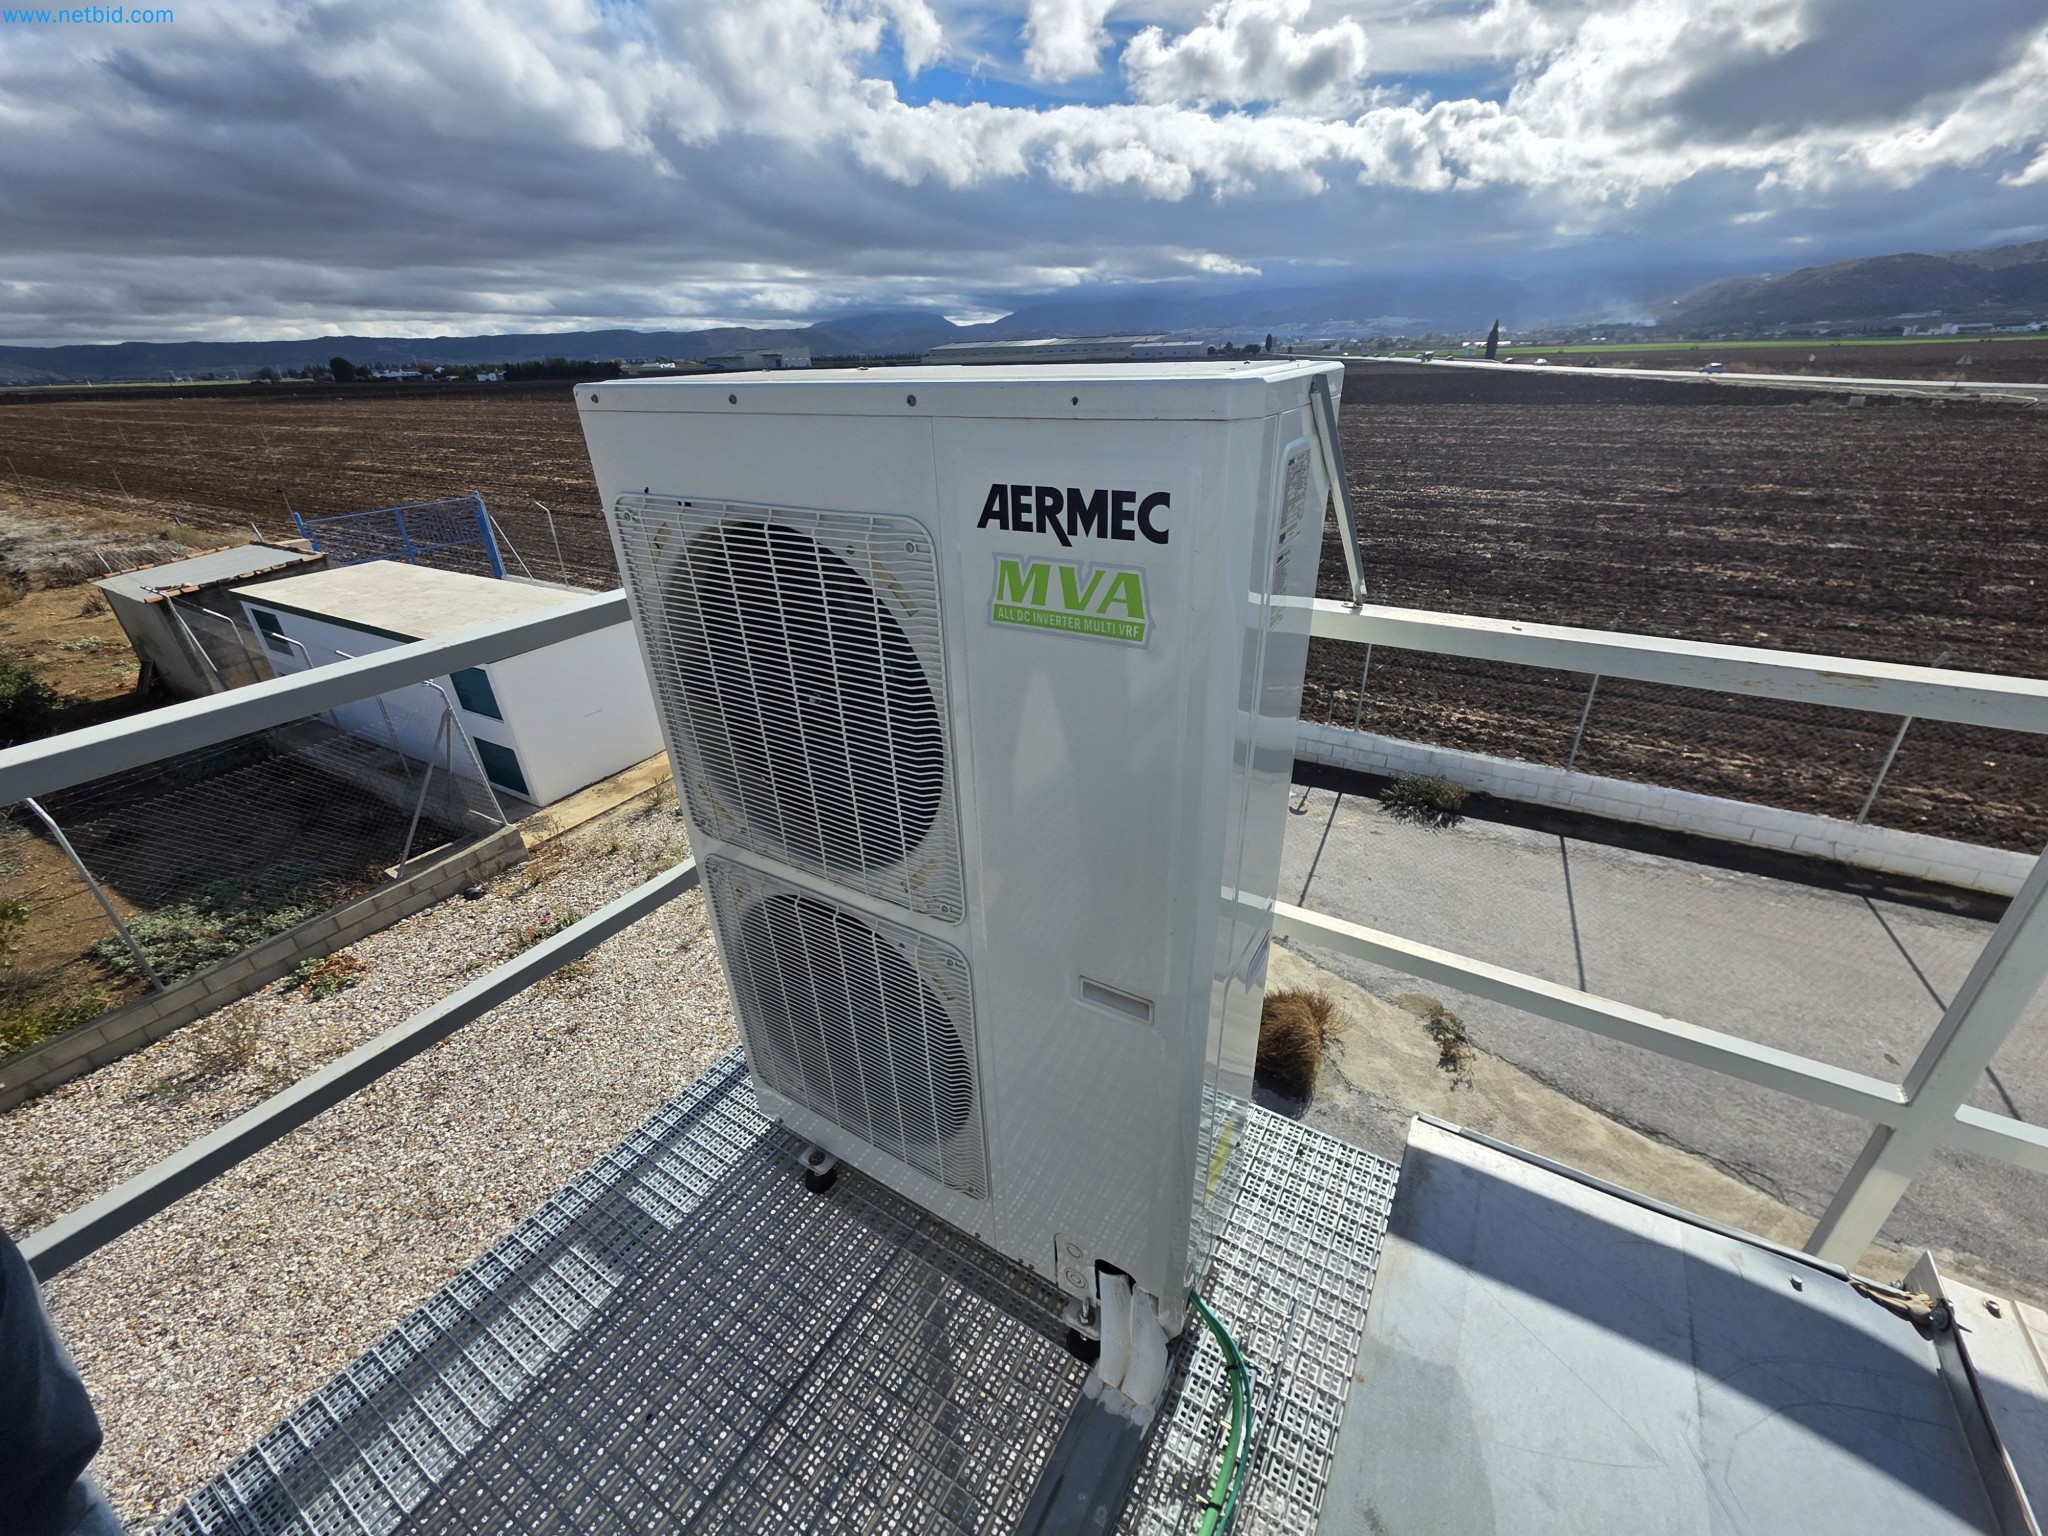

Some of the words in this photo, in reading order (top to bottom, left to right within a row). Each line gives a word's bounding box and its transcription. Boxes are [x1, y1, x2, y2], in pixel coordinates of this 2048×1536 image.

[976, 483, 1171, 547] AERMEC
[996, 559, 1146, 620] MVA
[997, 607, 1015, 620] ALL
[1017, 609, 1031, 622] DC
[1033, 611, 1081, 630] INVERTER
[1083, 619, 1116, 635] MULTI
[1118, 623, 1140, 638] VRF
